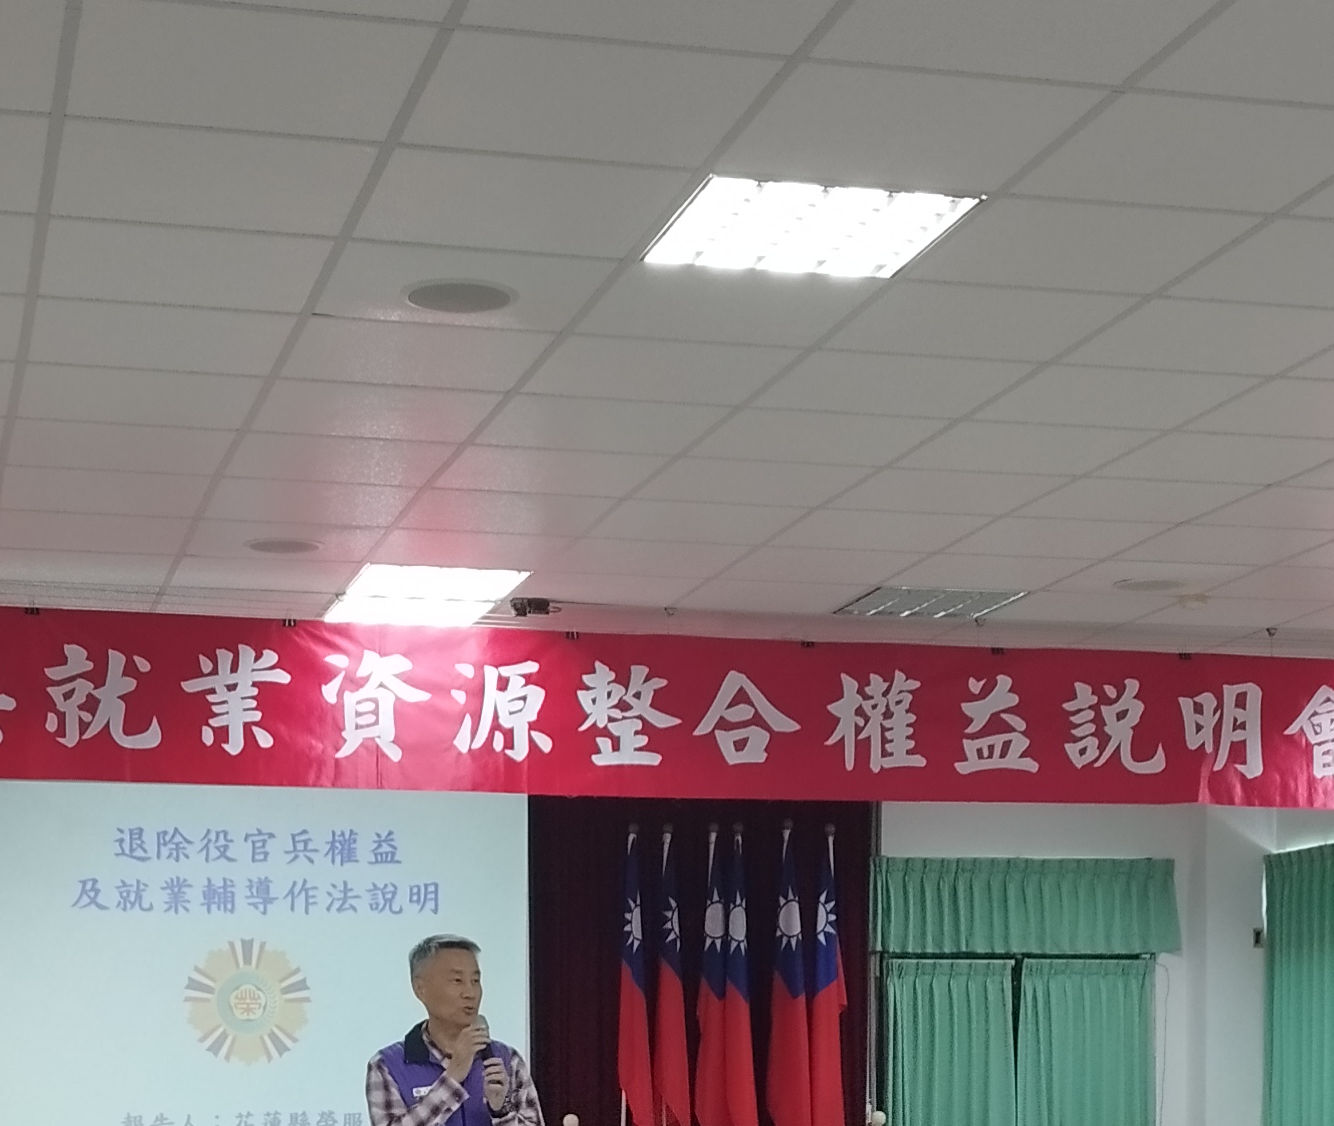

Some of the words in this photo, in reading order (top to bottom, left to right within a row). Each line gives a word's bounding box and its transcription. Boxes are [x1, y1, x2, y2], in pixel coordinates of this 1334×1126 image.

[113, 826, 403, 867] 退除役官兵權益
[71, 876, 441, 916] 及就業輔導作法說明
